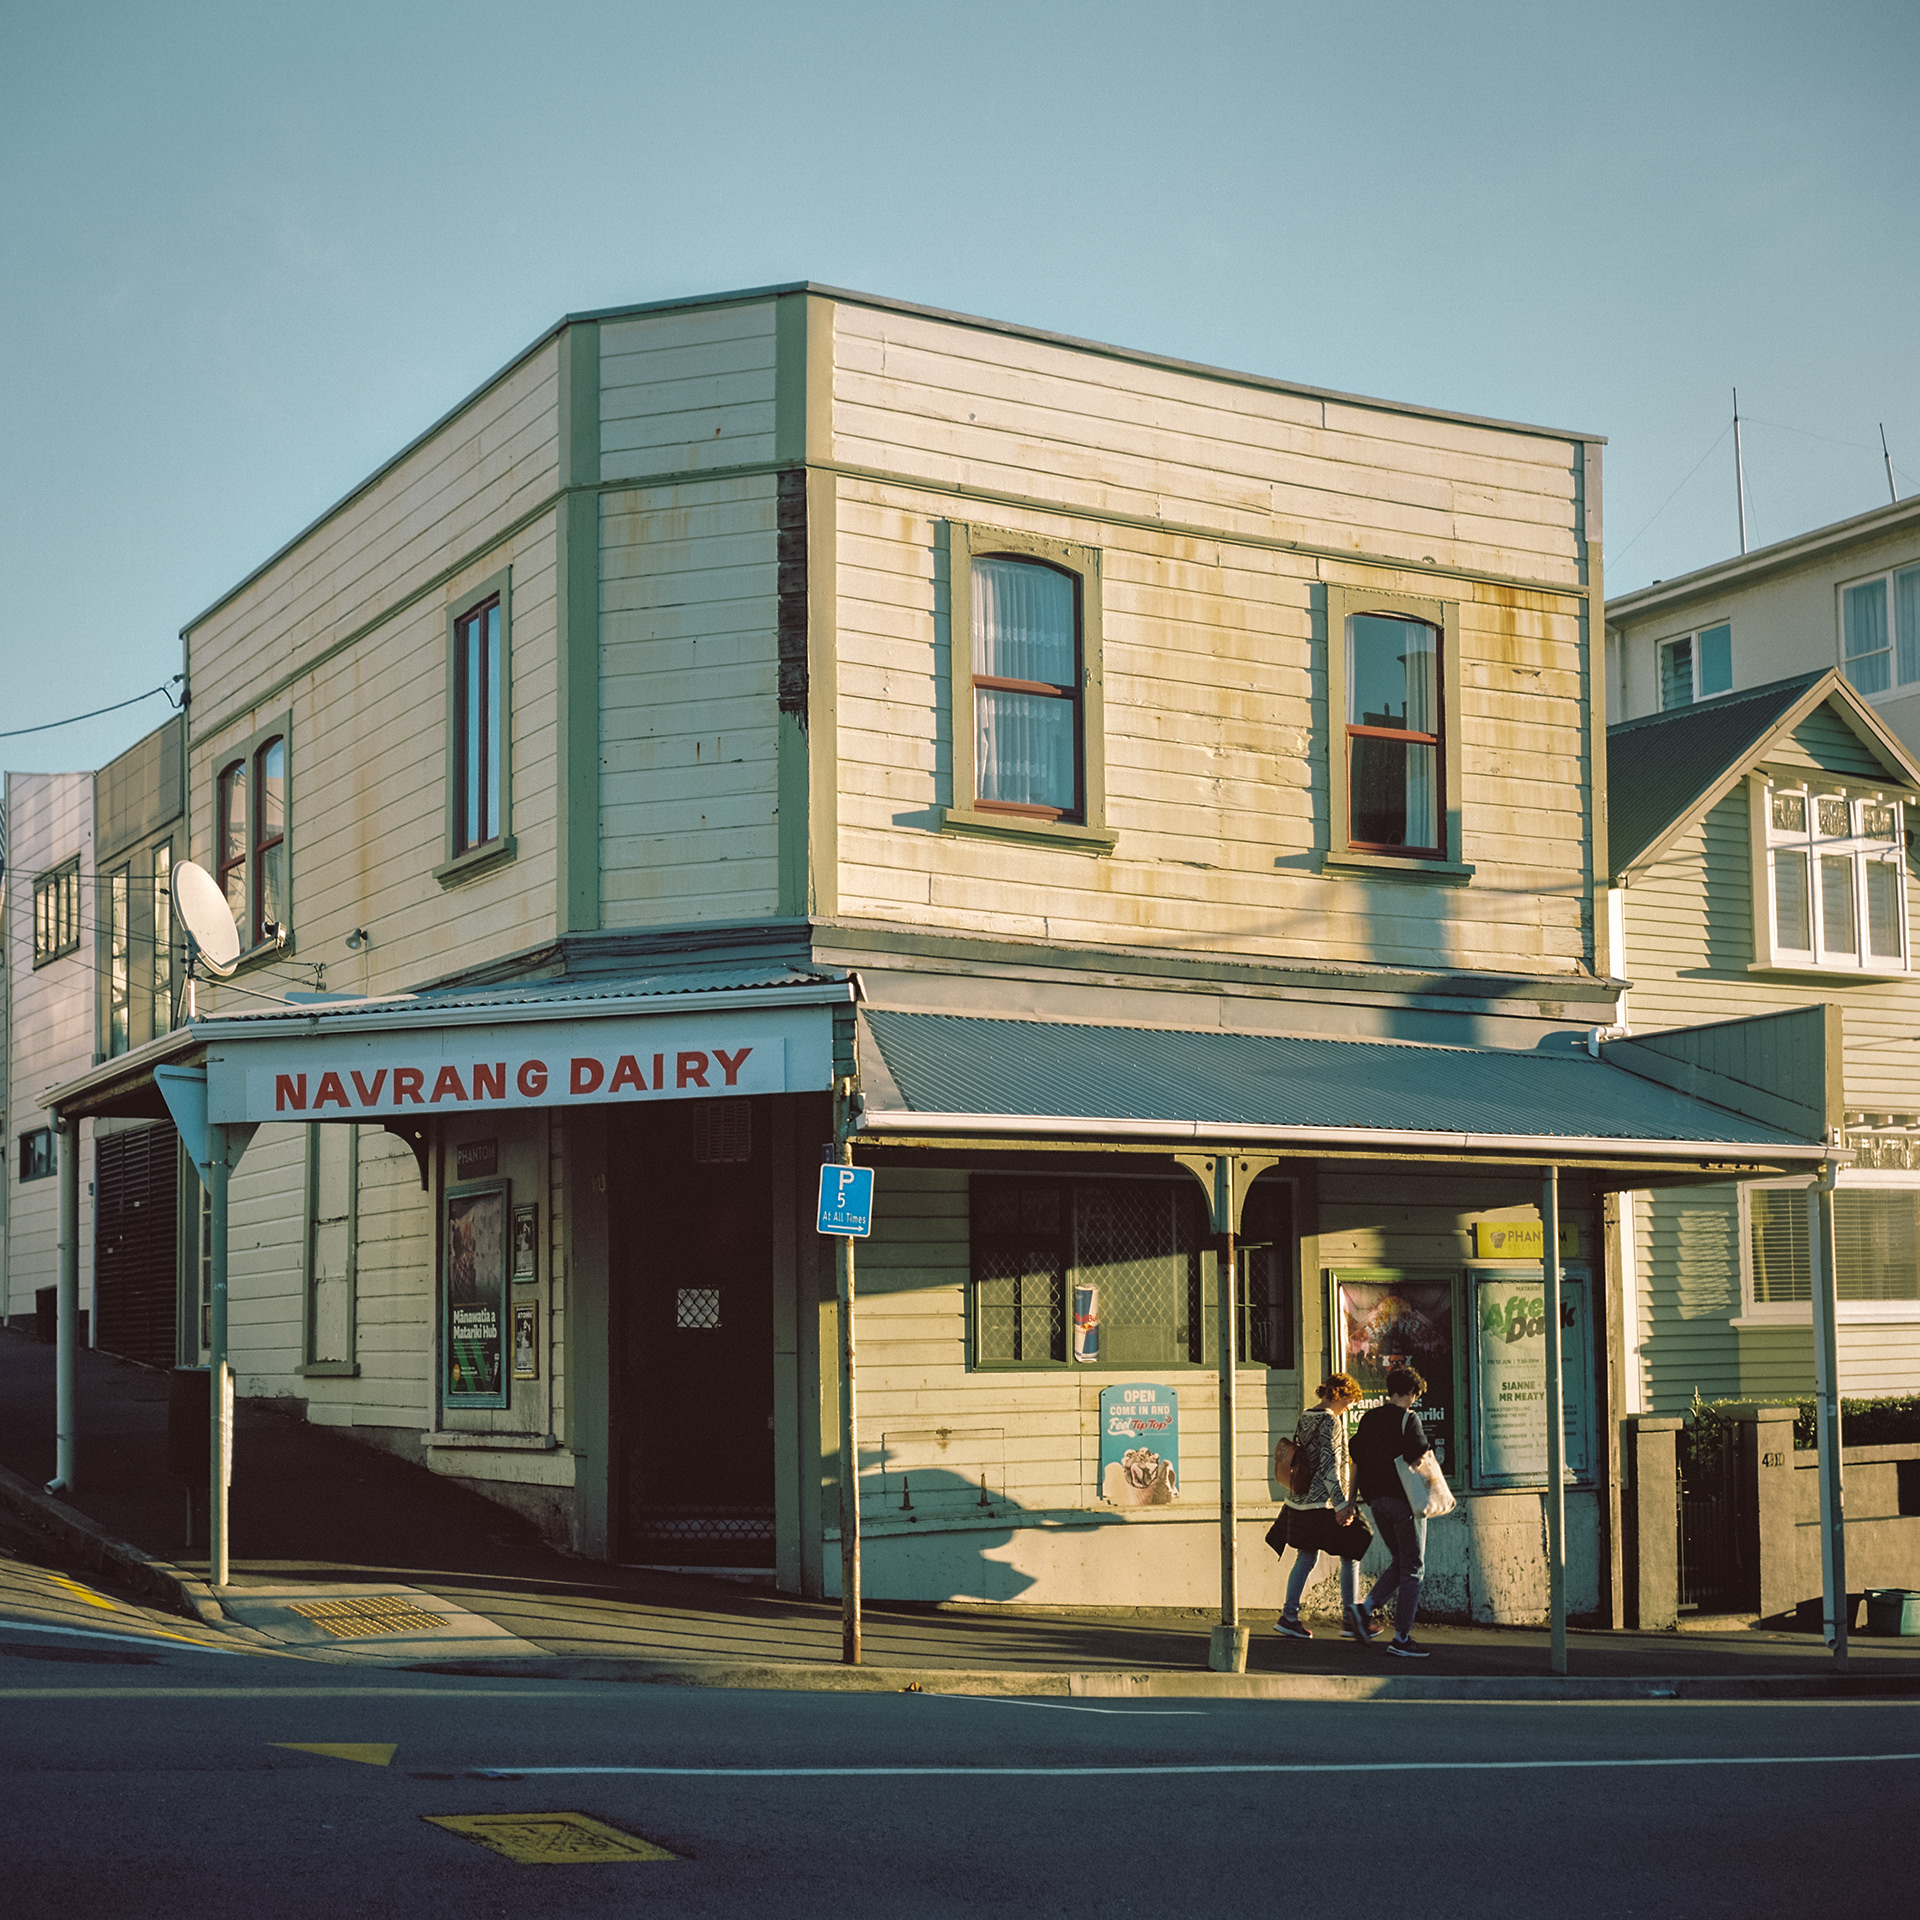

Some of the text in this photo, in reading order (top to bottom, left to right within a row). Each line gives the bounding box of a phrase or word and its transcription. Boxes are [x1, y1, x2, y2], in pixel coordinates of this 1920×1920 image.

[275, 1047, 755, 1112] NAVRANG DAIRY
[839, 1169, 855, 1191] P
[837, 1192, 846, 1209] 5
[822, 1210, 867, 1225] At All Times
[1507, 1230, 1567, 1242] PHANM
[1482, 1295, 1546, 1334] Afte
[1505, 1301, 1577, 1344] Dak
[453, 1323, 497, 1340] Matariki Hub
[1501, 1380, 1536, 1391] SIANNE
[1123, 1389, 1156, 1403] OPEN
[1499, 1391, 1545, 1402] MR MEATY
[1109, 1405, 1171, 1416] COME IN AND
[1419, 1407, 1445, 1421] ariki
[1131, 1419, 1148, 1431] Tip
[1148, 1419, 1167, 1431] Top
